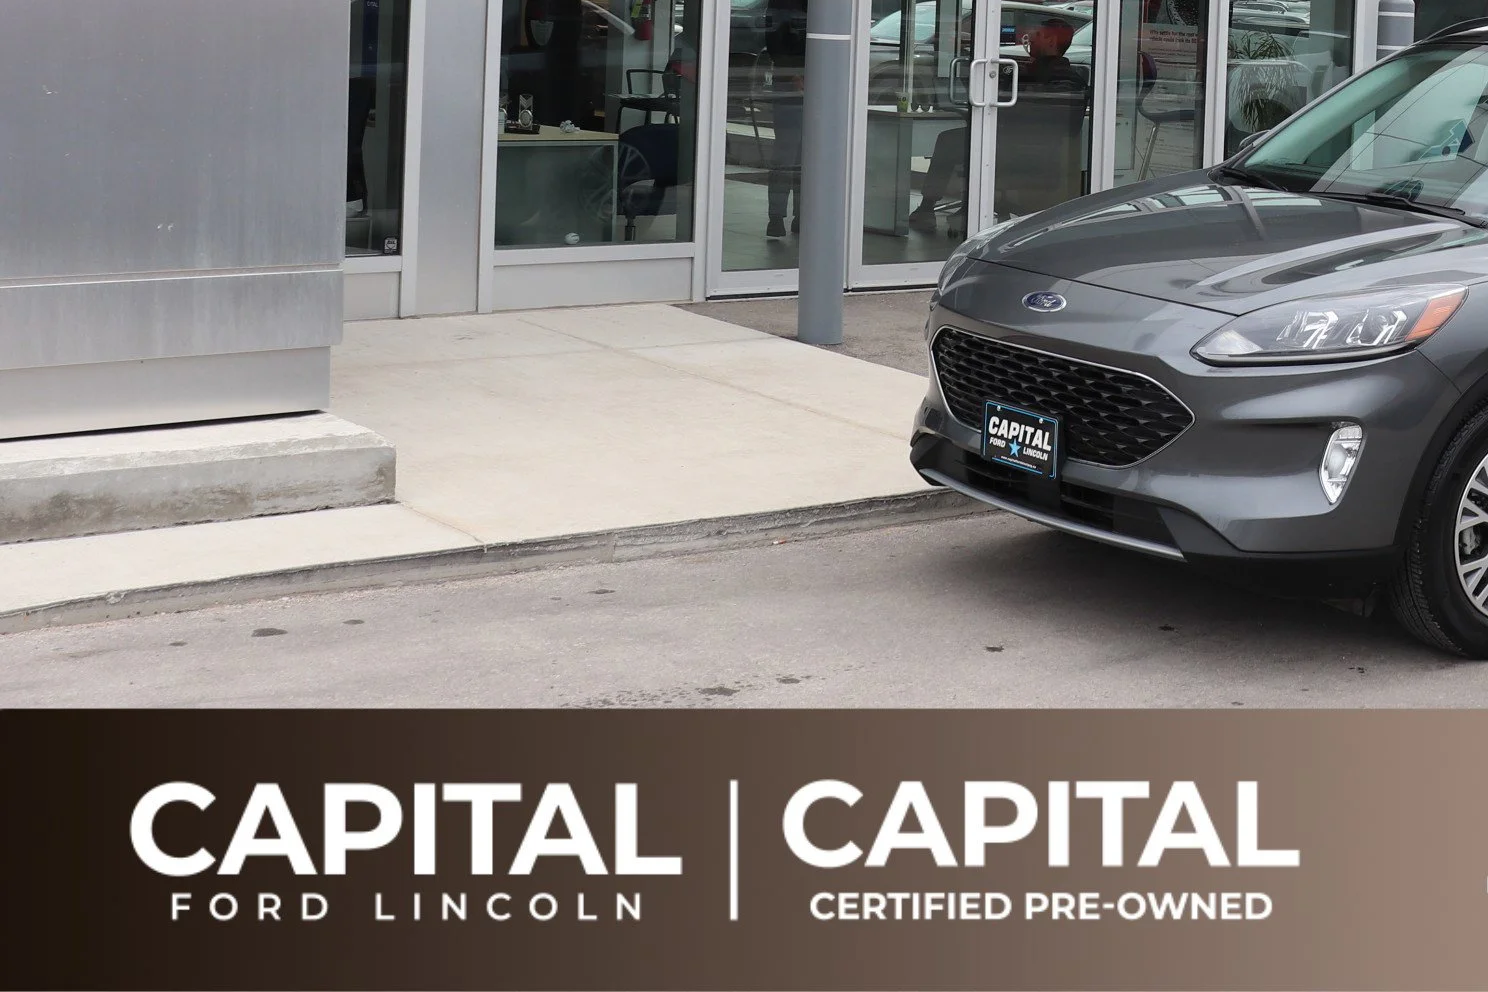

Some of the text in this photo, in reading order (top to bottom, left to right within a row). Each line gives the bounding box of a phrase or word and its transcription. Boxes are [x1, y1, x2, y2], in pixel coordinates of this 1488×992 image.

[988, 415, 1052, 451] CAPITAL
[989, 436, 1049, 461] FORD LINCOLN
